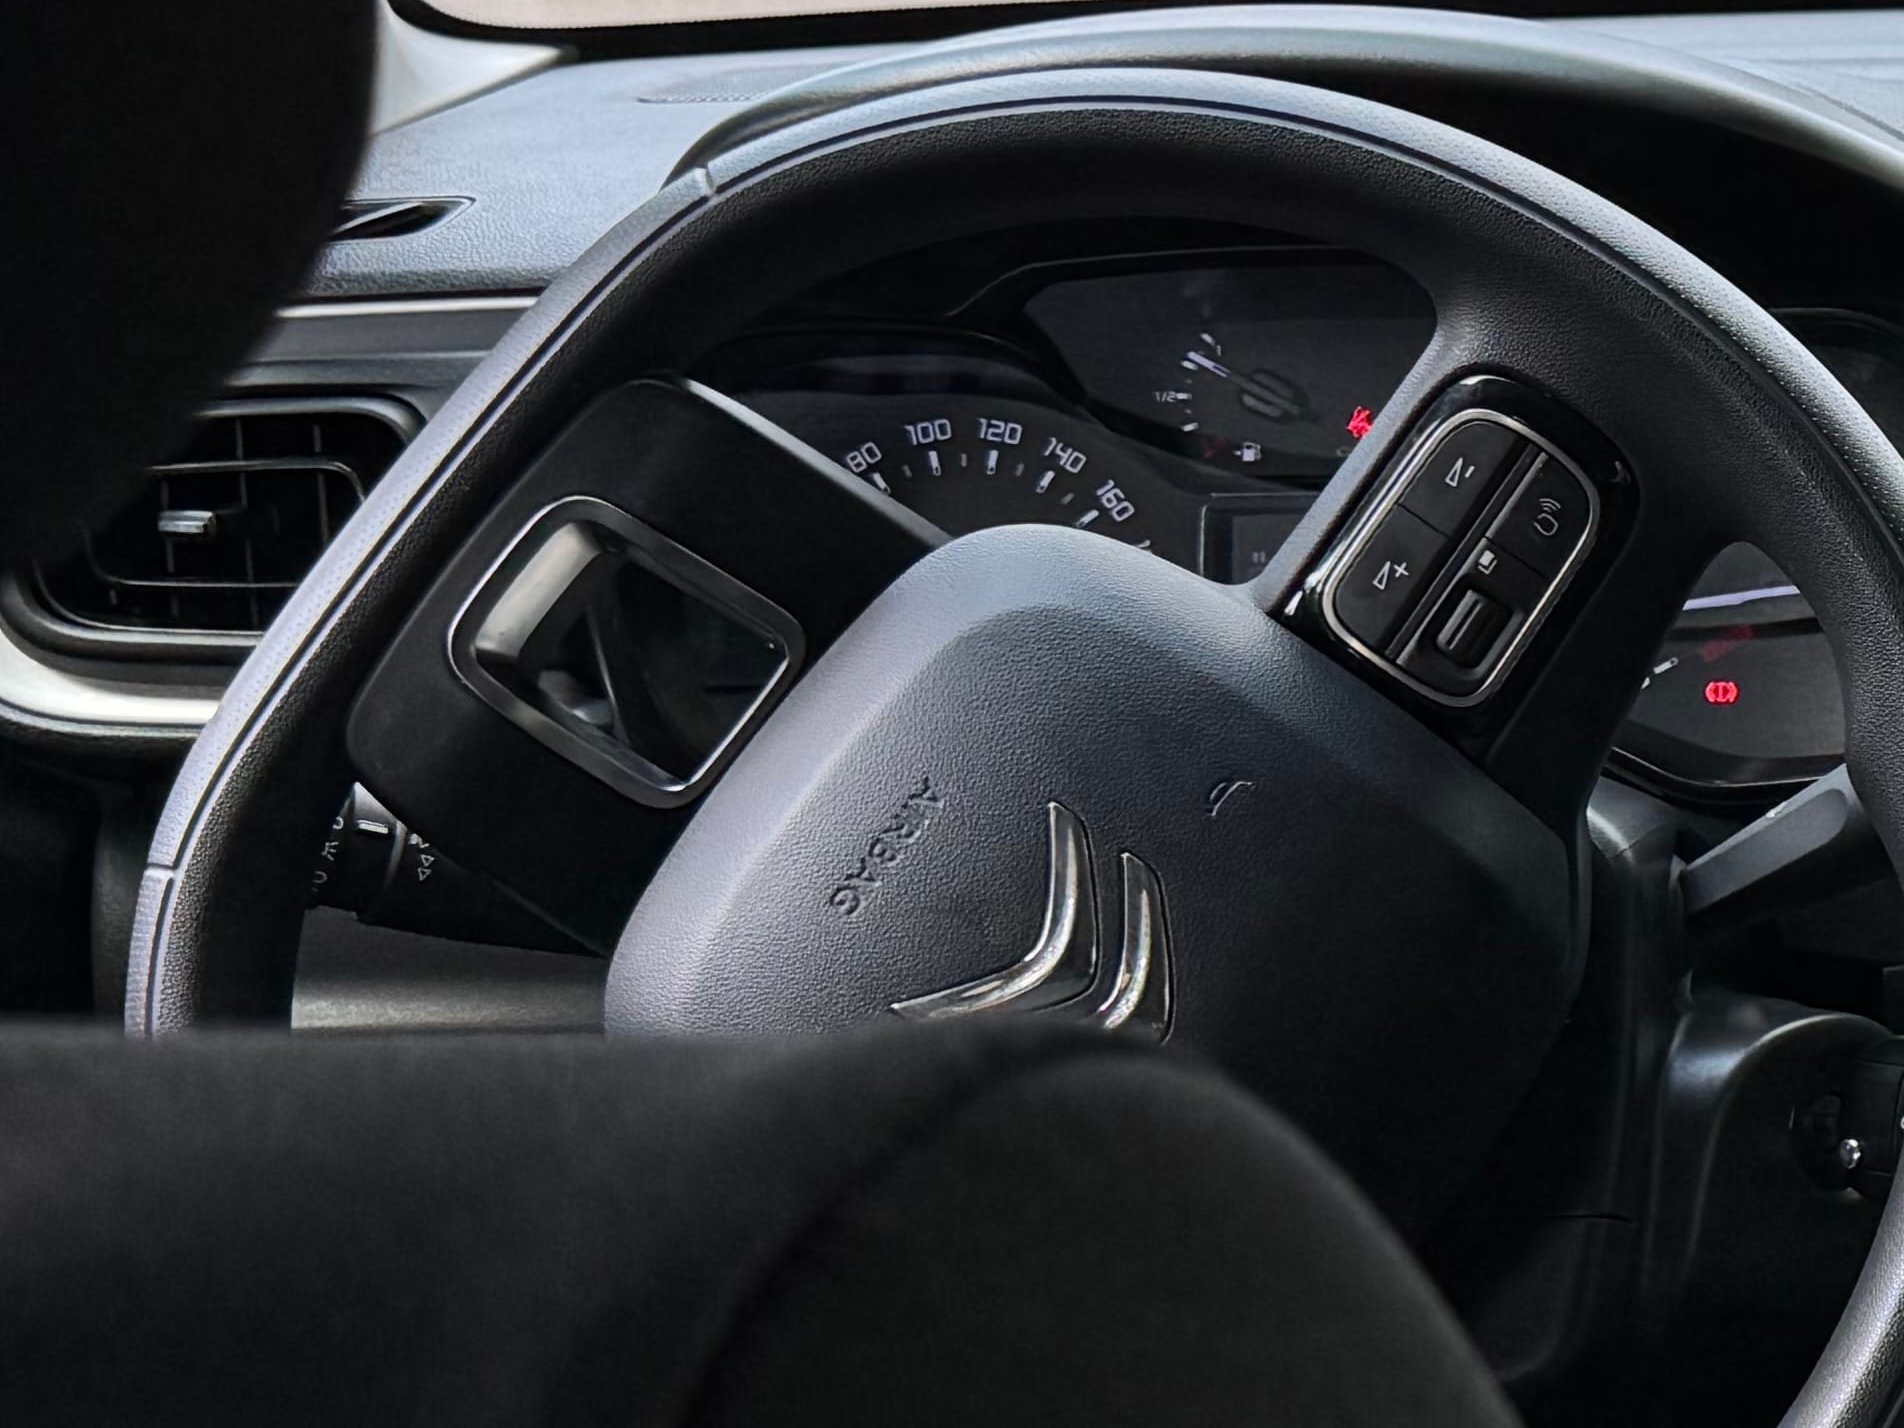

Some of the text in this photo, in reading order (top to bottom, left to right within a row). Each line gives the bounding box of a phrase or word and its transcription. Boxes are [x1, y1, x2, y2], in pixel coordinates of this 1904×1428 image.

[904, 418, 952, 447] 100
[978, 416, 1022, 445] 120
[845, 441, 882, 474] 80
[1043, 435, 1087, 474] 140
[1095, 478, 1135, 523] 160
[829, 776, 944, 916] AIRBAG
